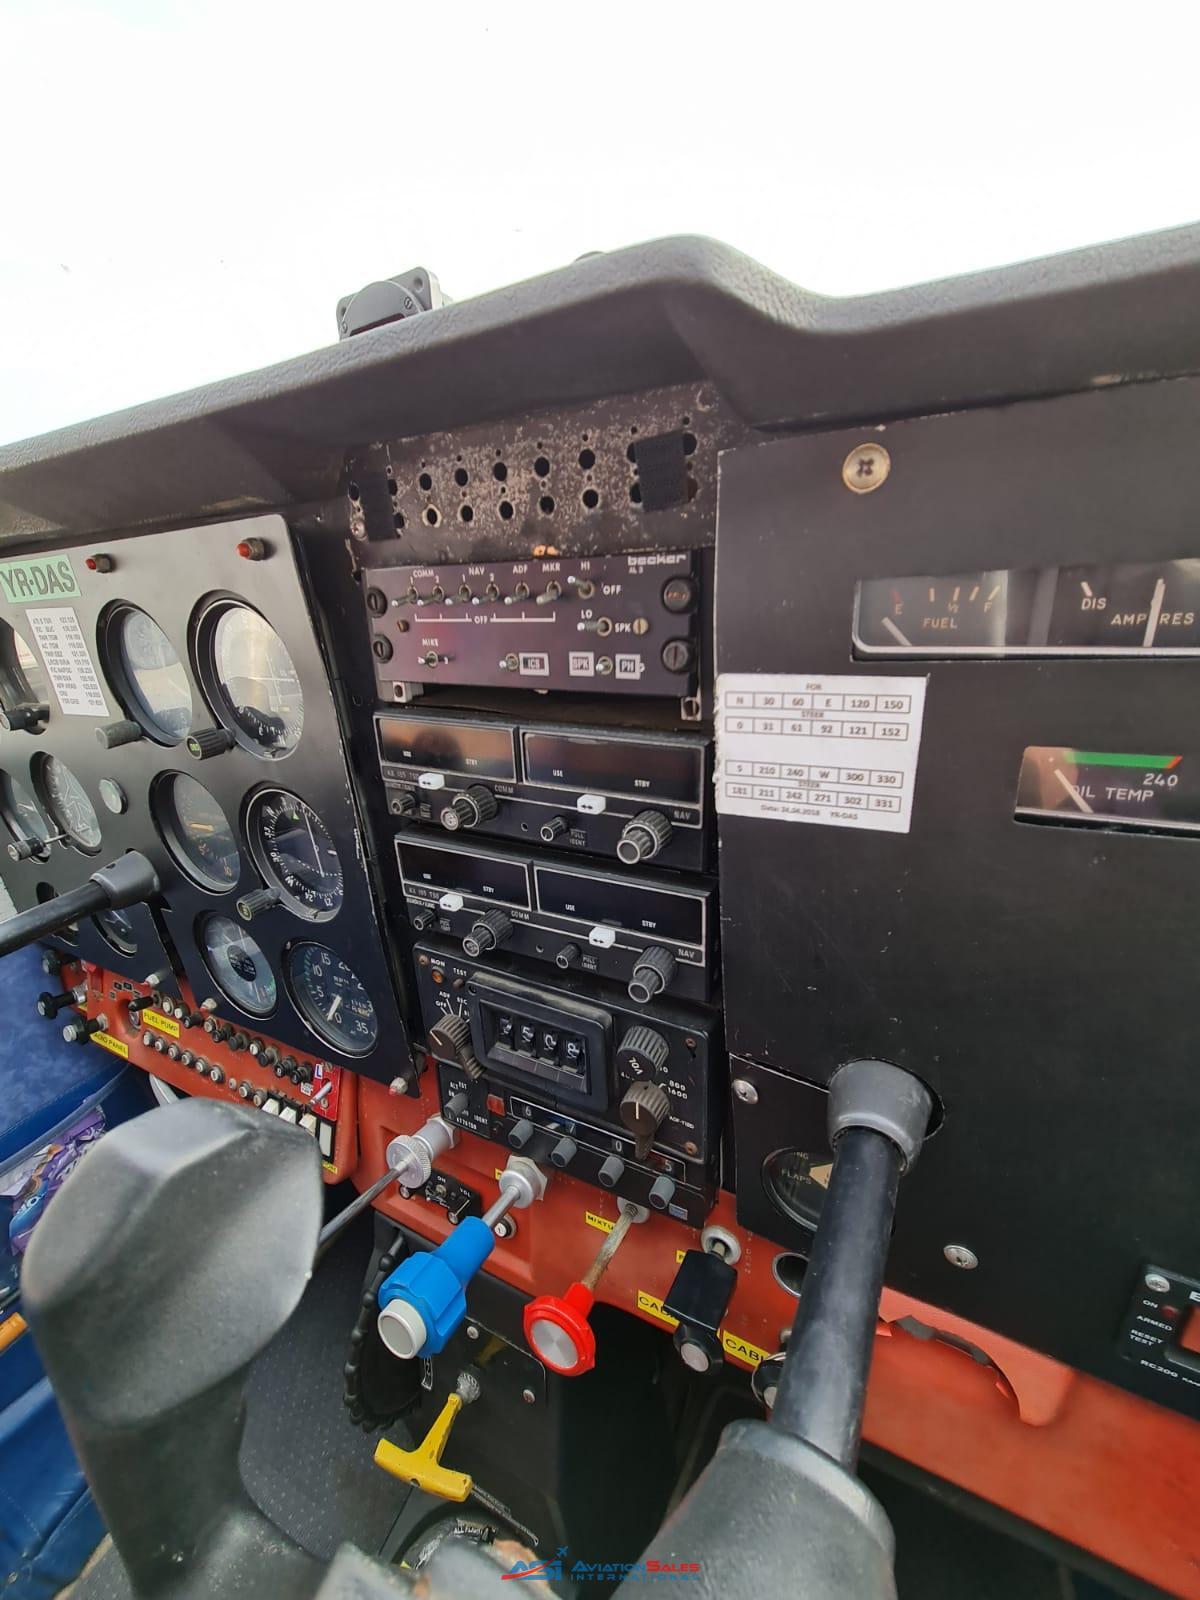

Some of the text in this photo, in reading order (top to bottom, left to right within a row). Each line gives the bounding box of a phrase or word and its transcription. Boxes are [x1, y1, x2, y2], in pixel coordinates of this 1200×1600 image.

[627, 554, 687, 566] becker
[512, 565, 528, 574] ADF
[542, 562, 560, 572] MKR
[581, 561, 590, 570] HI
[413, 570, 434, 578] COMM
[468, 567, 485, 576] NAV
[603, 584, 622, 595] OFF
[895, 603, 903, 615] E
[984, 602, 992, 613] F
[1081, 598, 1107, 610] DIS
[581, 610, 592, 619] LO
[1110, 612, 1195, 625] AMPRES
[474, 616, 488, 624] OFF
[923, 618, 958, 629] FUEL
[615, 623, 632, 632] SPK
[422, 638, 438, 646] MIKE
[573, 658, 588, 668] SPK
[792, 698, 804, 706] 60
[851, 700, 870, 708] 120
[884, 700, 904, 708] 150
[792, 724, 802, 732] 61
[850, 726, 867, 735] 121
[882, 728, 900, 736] 152
[552, 769, 563, 778] USE
[846, 773, 864, 781] 300
[877, 775, 896, 783] 330
[634, 780, 650, 788] STBY
[1142, 773, 1178, 786] 240
[494, 784, 514, 794] COMM
[758, 789, 774, 797] 211
[814, 793, 831, 802] 271
[844, 796, 862, 806] 302
[875, 799, 892, 808] 331
[1106, 787, 1154, 802] TEMP
[674, 810, 690, 820] NAV
[565, 904, 576, 912] USE
[511, 910, 530, 920] COMM
[642, 920, 656, 929] STBY
[678, 948, 695, 958] NAV
[430, 958, 446, 966] MON
[453, 968, 467, 976] TEST
[144, 1012, 178, 1031] FUEL PUMP
[355, 1020, 368, 1034] 35
[668, 1086, 688, 1100] 1600
[665, 1162, 672, 1172] 5
[782, 1168, 812, 1184] FLAPS
[1142, 1300, 1158, 1308] ON
[1136, 1315, 1172, 1332] ARMED
[1130, 1329, 1164, 1344] RESET
[1130, 1335, 1154, 1346] TEST
